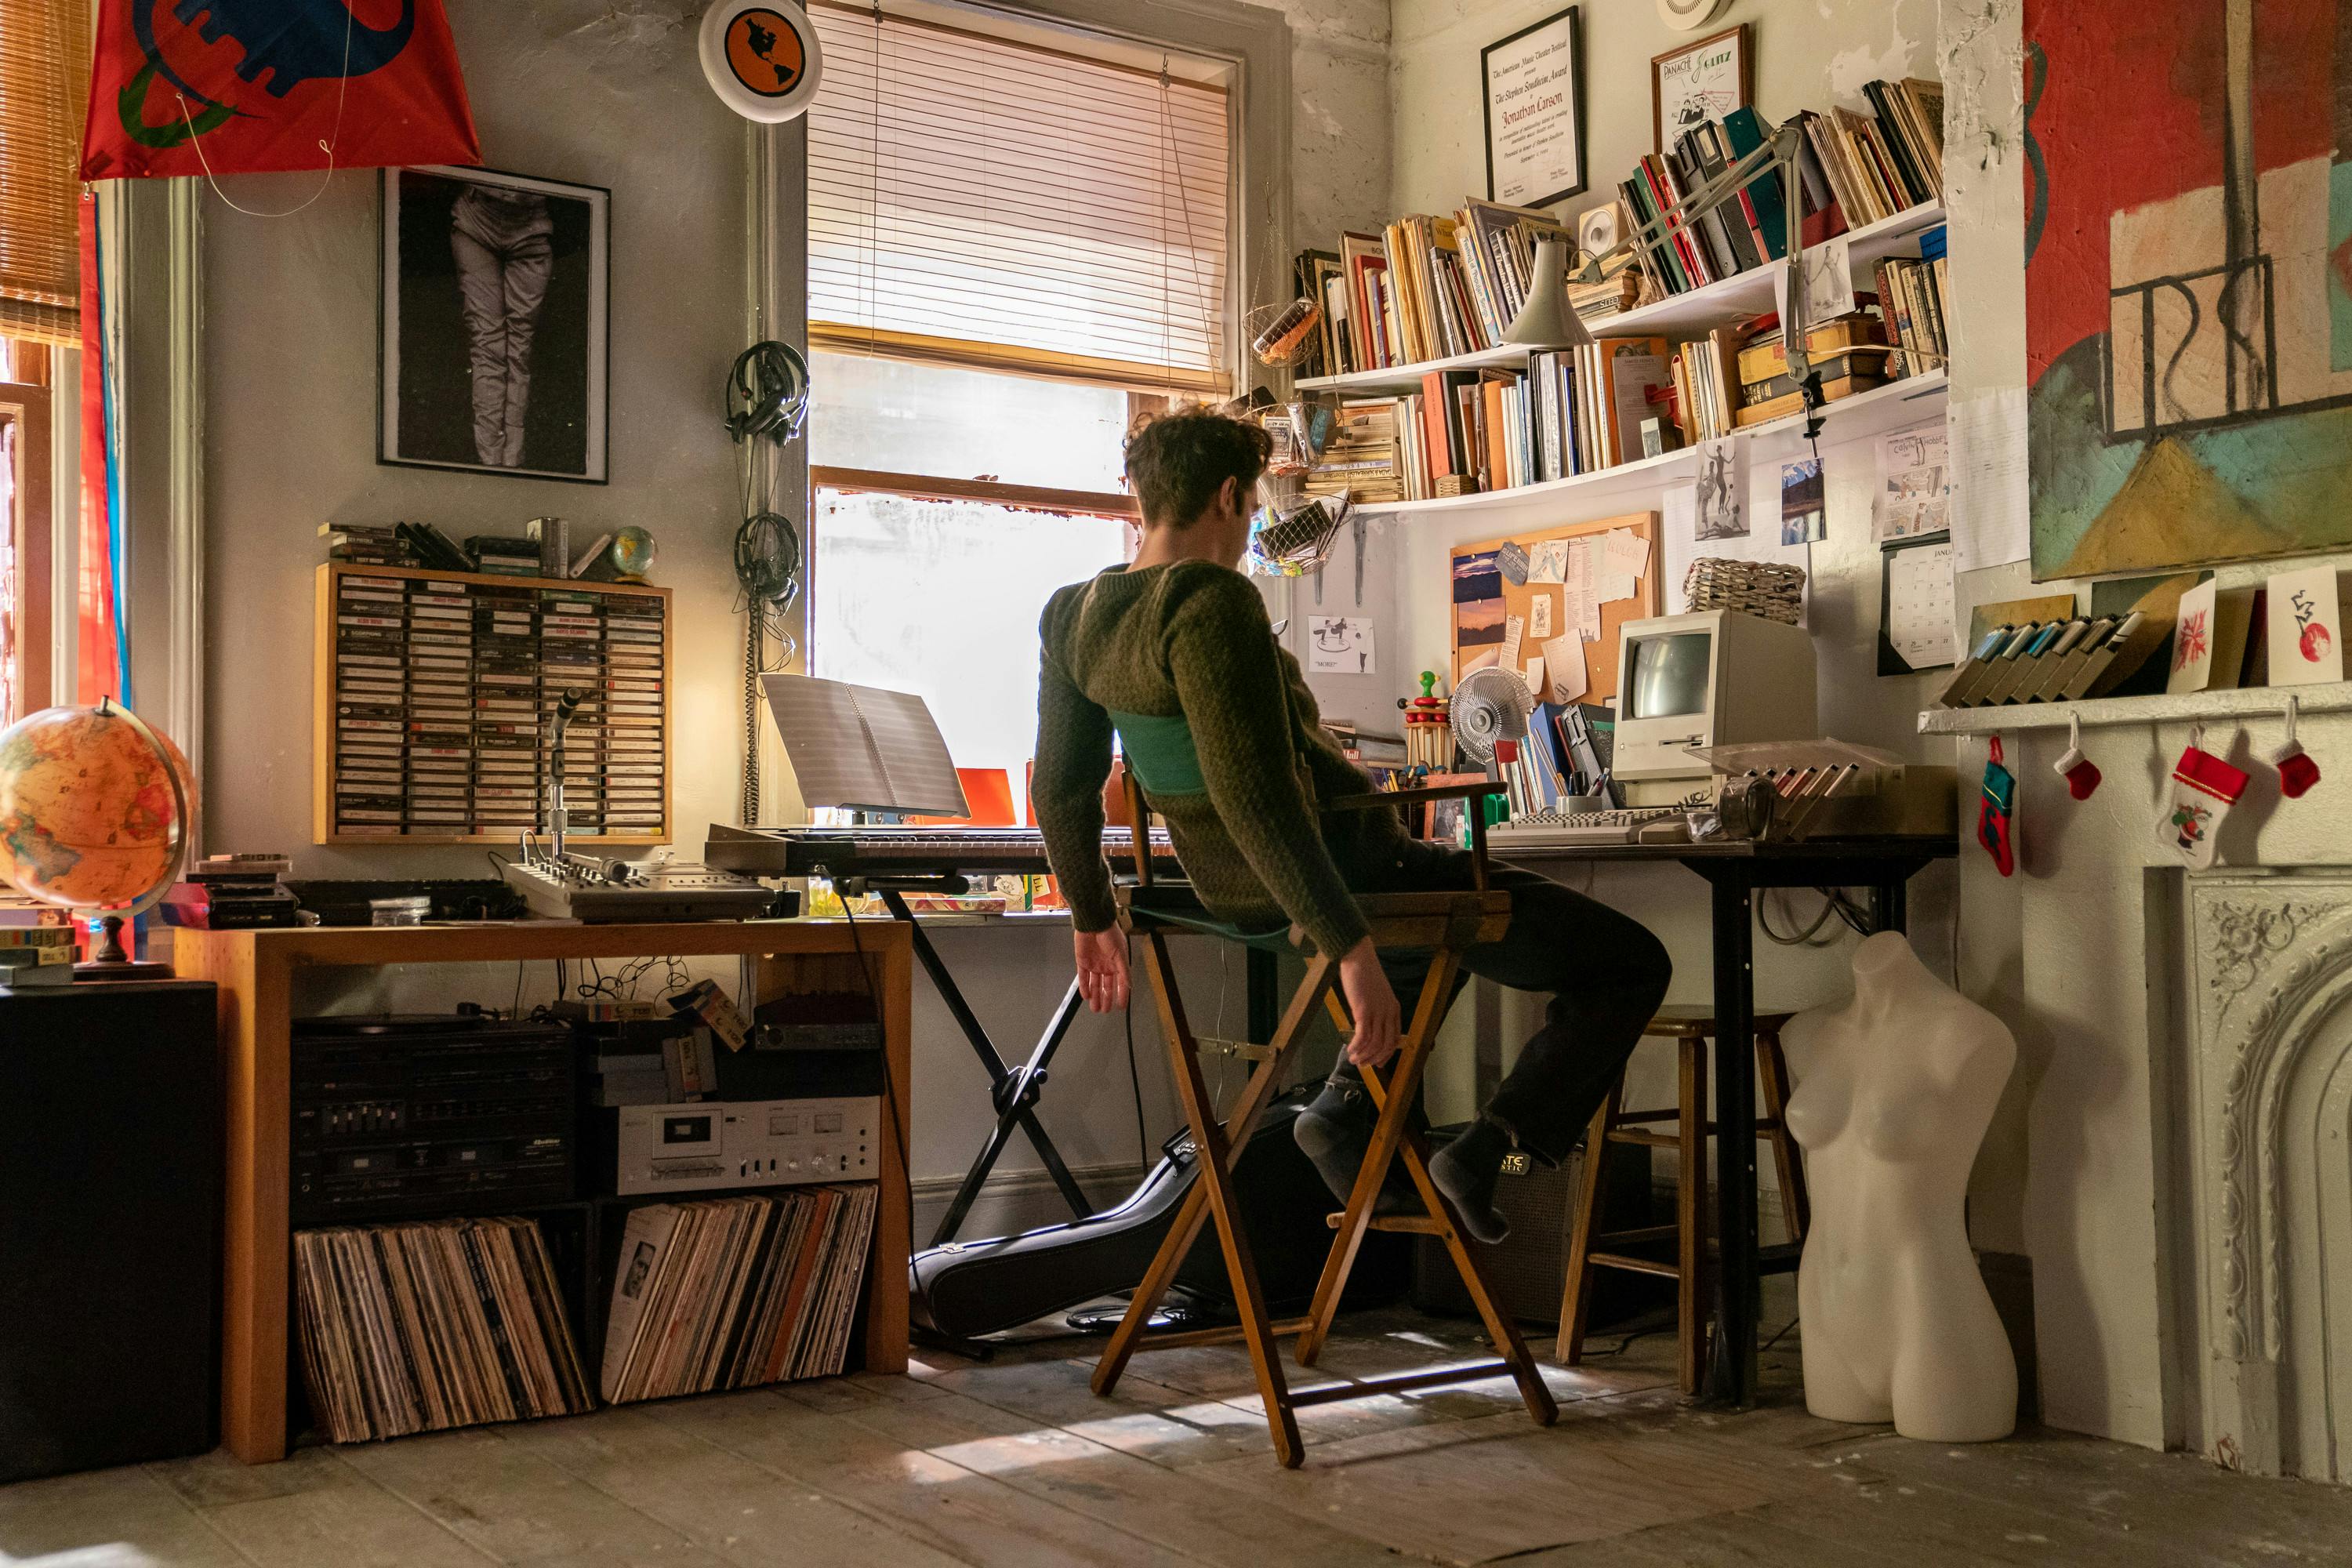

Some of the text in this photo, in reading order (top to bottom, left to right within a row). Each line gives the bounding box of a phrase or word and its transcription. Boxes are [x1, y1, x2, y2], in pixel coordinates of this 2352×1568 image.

[1501, 63, 1520, 76] American
[1521, 55, 1534, 68] Music
[1551, 39, 1567, 53] Festival
[1664, 56, 1691, 76] PANACHE
[1504, 86, 1523, 100] Stephen
[1525, 75, 1549, 92] Sondheim
[1549, 64, 1567, 83] Award
[1502, 93, 1563, 129] Jonathan Larson
[1462, 238, 1475, 263] Festival
[1472, 270, 1484, 297] Popular
[1479, 297, 1490, 318] Songs
